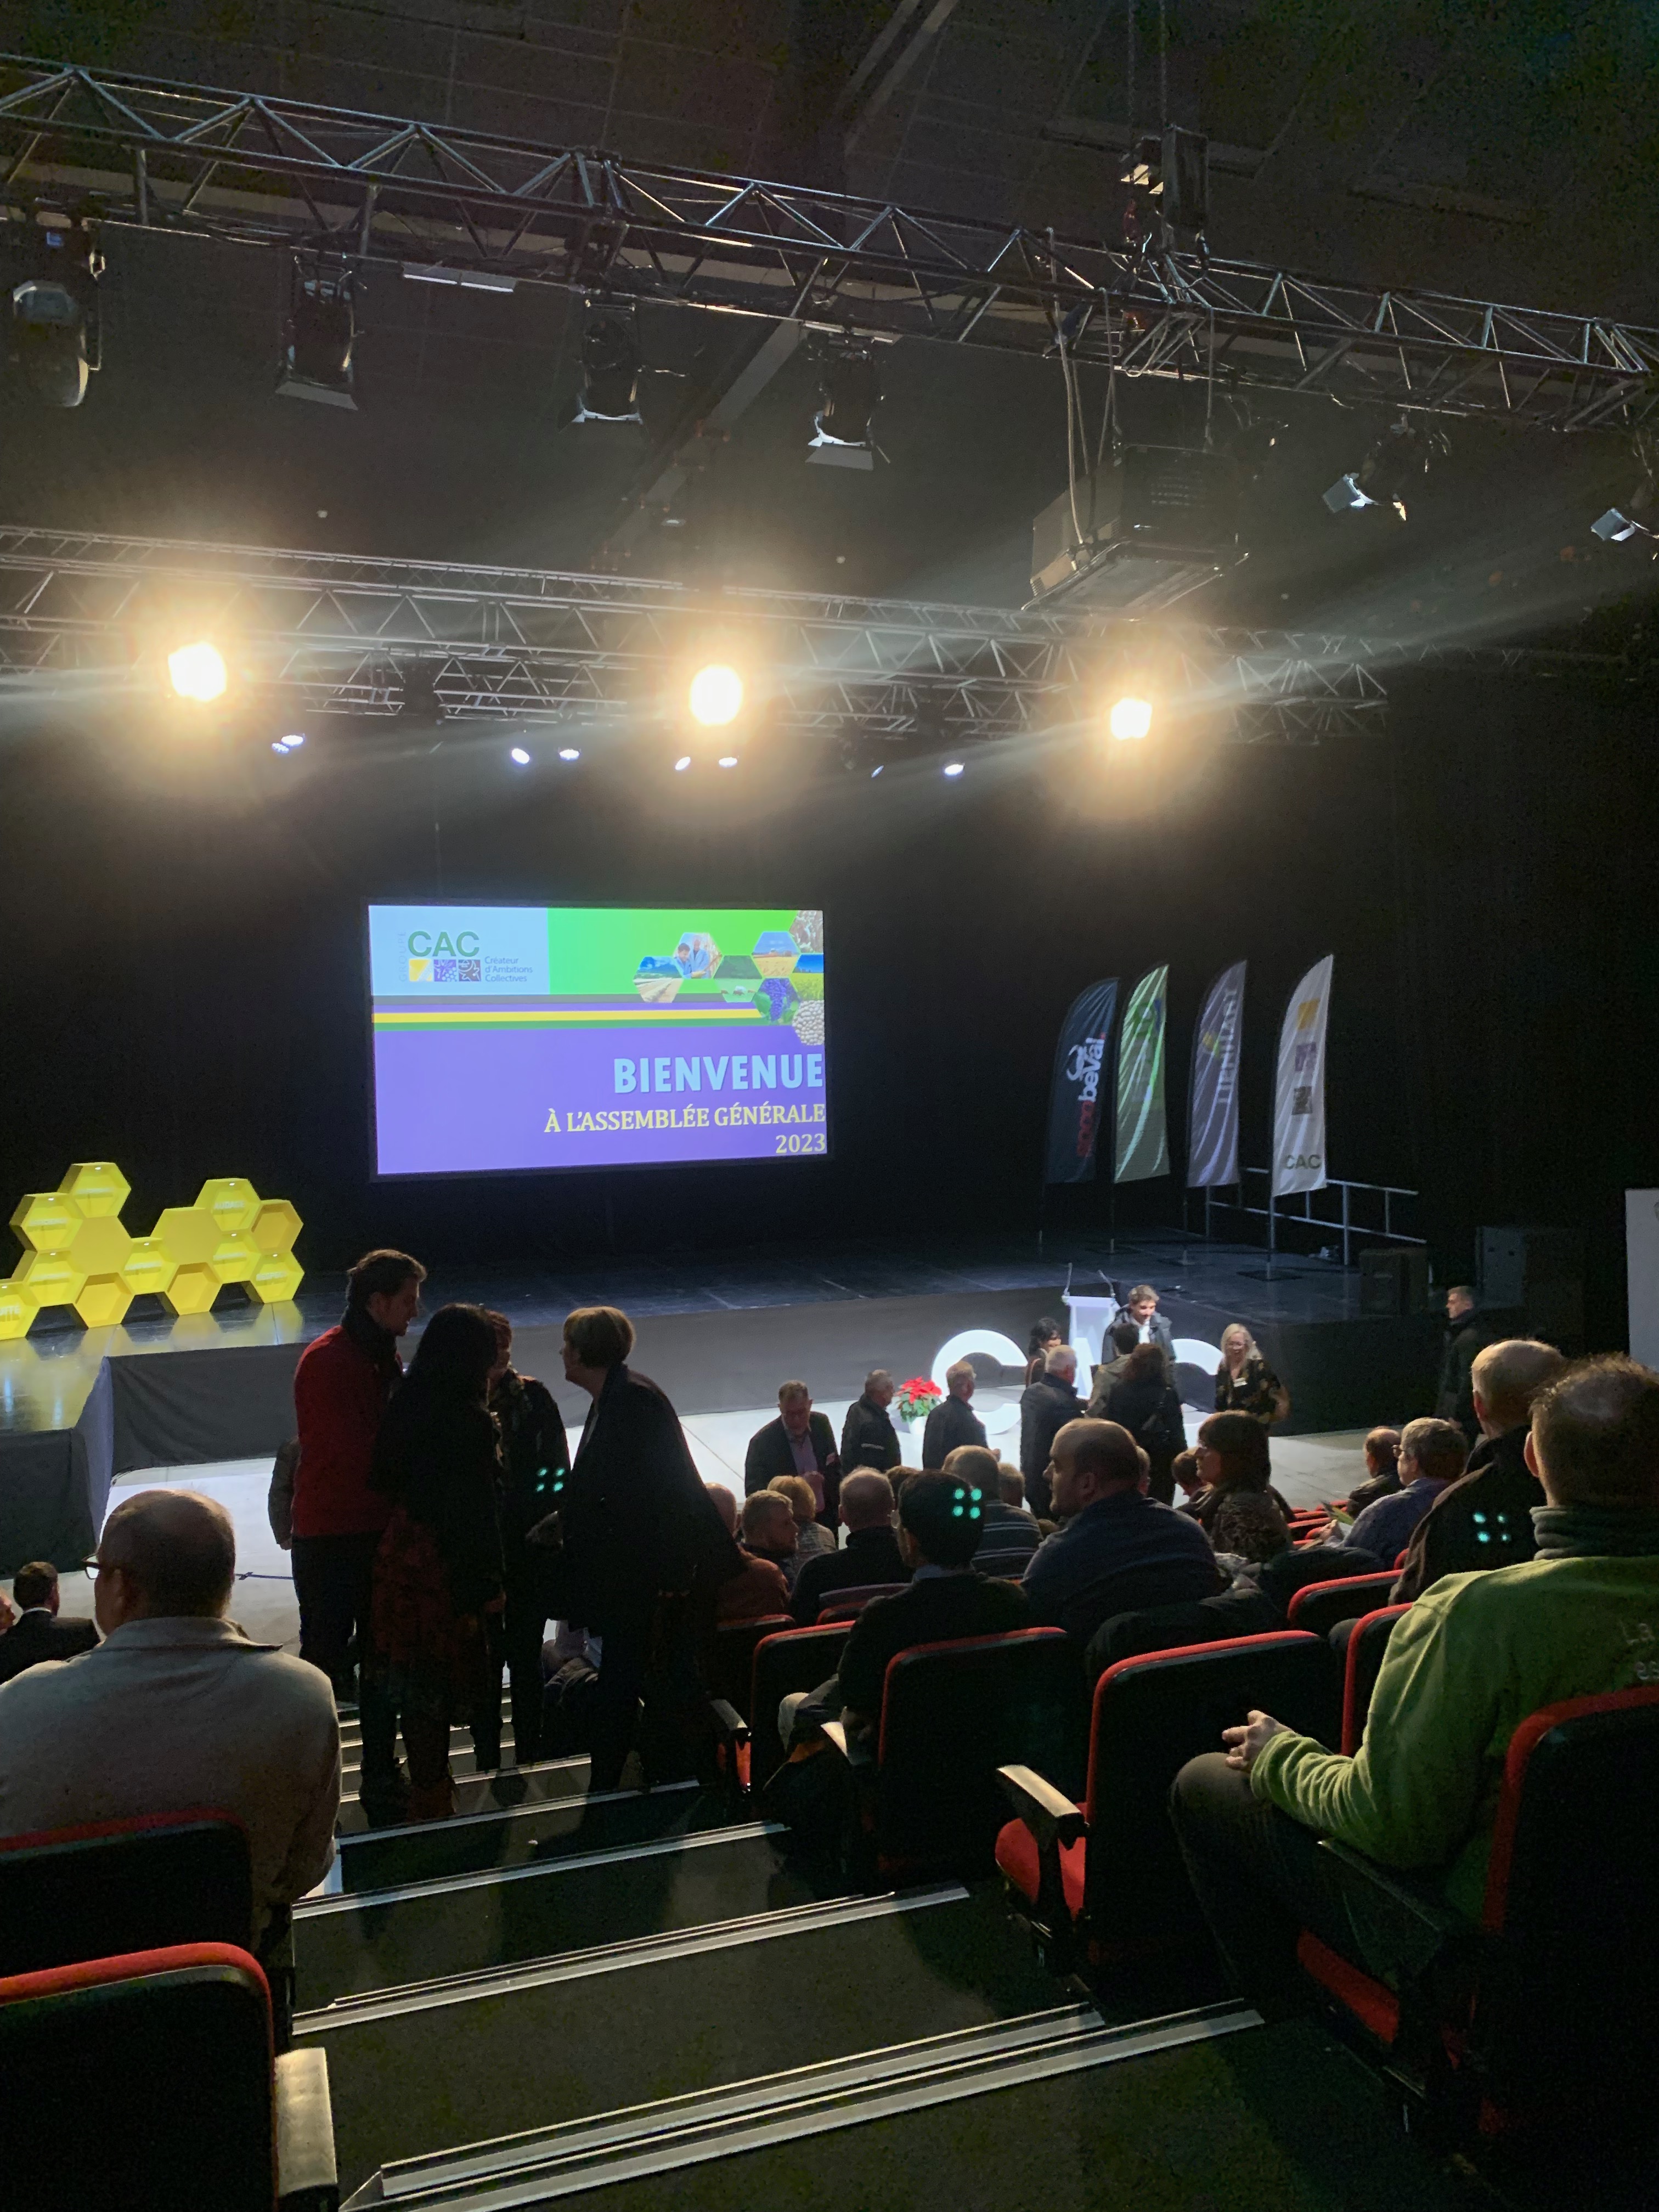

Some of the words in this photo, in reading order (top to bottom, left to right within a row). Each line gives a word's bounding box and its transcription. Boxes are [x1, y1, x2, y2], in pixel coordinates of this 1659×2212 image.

[408, 930, 480, 957] CAC
[398, 931, 407, 982] GROUPE
[484, 956, 519, 964] Créateur
[484, 965, 533, 973] d'Ambitions
[485, 973, 527, 982] Collectives
[613, 1053, 823, 1093] BIENVENUE
[544, 1108, 562, 1133] À
[567, 1104, 710, 1132] L'ASSEMBLÉE
[714, 1101, 825, 1127] GÉNÉRALE
[775, 1133, 826, 1154] 2023
[1284, 1154, 1322, 1170] CAC
